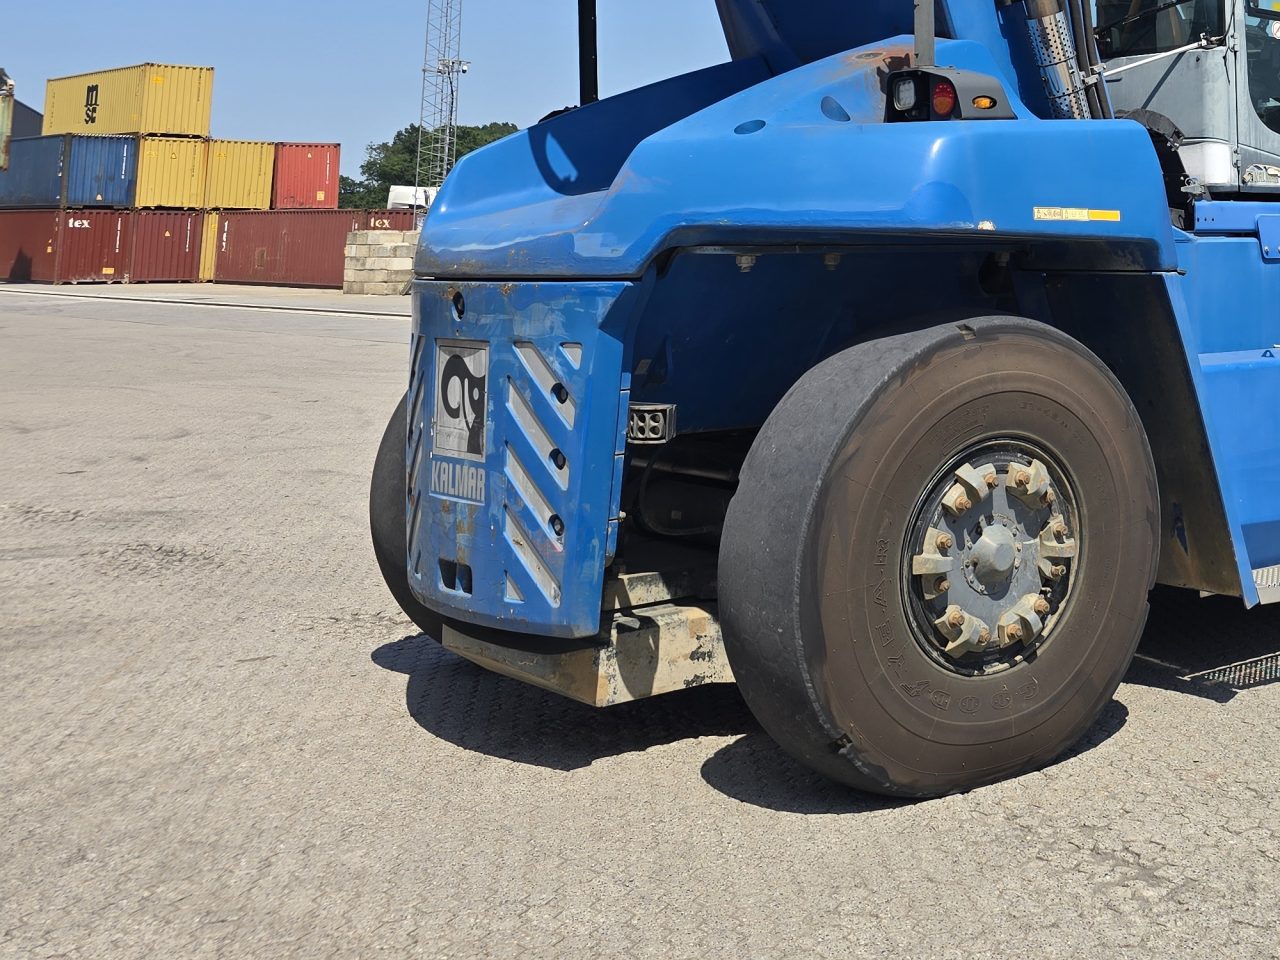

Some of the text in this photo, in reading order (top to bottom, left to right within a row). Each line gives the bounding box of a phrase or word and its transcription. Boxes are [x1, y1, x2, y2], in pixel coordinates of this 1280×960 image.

[68, 218, 91, 228] tex
[370, 217, 391, 228] tex
[431, 460, 486, 501] KALMAR
